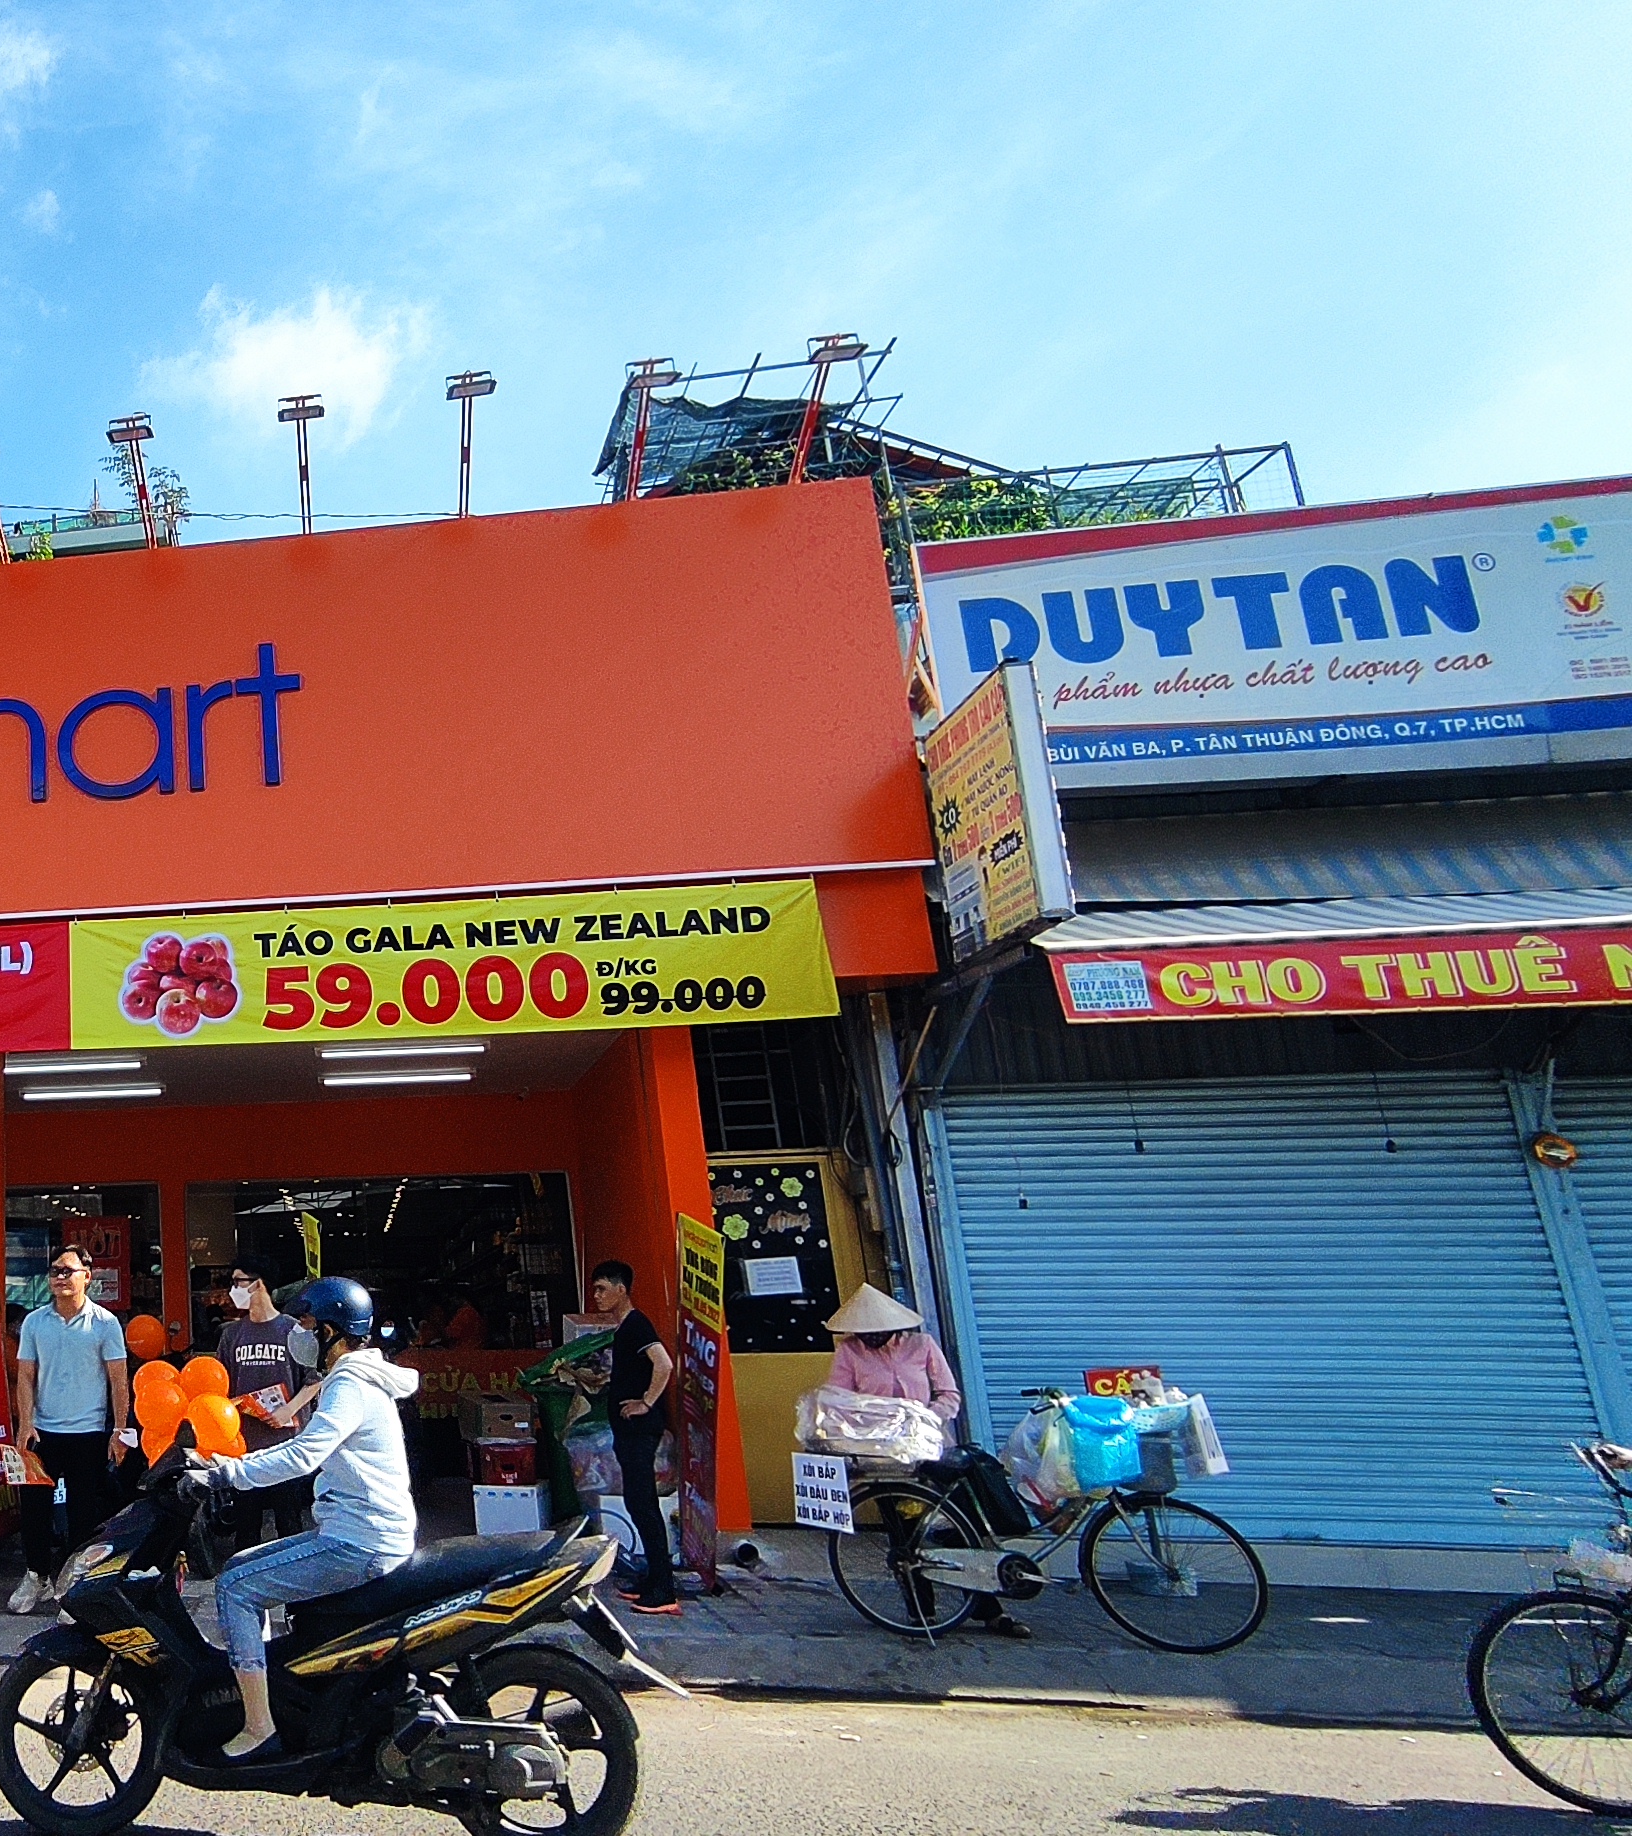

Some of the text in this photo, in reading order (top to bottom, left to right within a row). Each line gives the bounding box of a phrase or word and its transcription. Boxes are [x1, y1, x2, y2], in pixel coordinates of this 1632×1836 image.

[1053, 652, 1495, 709] phẩm nhựa chất lượng cao
[1084, 741, 1128, 760] VĂN
[1132, 741, 1166, 759] BA,
[1172, 738, 1191, 755] P.
[1194, 731, 1239, 753] TÂN
[1241, 727, 1316, 752] THUẬN
[1319, 723, 1390, 744] ĐÔNG,
[1393, 720, 1436, 740] Q.7,
[1438, 713, 1526, 733] TP.HCM
[253, 904, 772, 958] TÁO GALA NEW ZEALAND
[261, 950, 657, 1032] 59.000 Đ/KG
[1159, 955, 1327, 1008] CHO
[1339, 935, 1578, 1001] THUÊ
[600, 975, 767, 1017] 99.000
[1125, 989, 1146, 1000] 277
[1128, 1000, 1149, 1008] 277
[235, 1343, 286, 1363] COLGATE
[817, 1461, 837, 1480] BẮP
